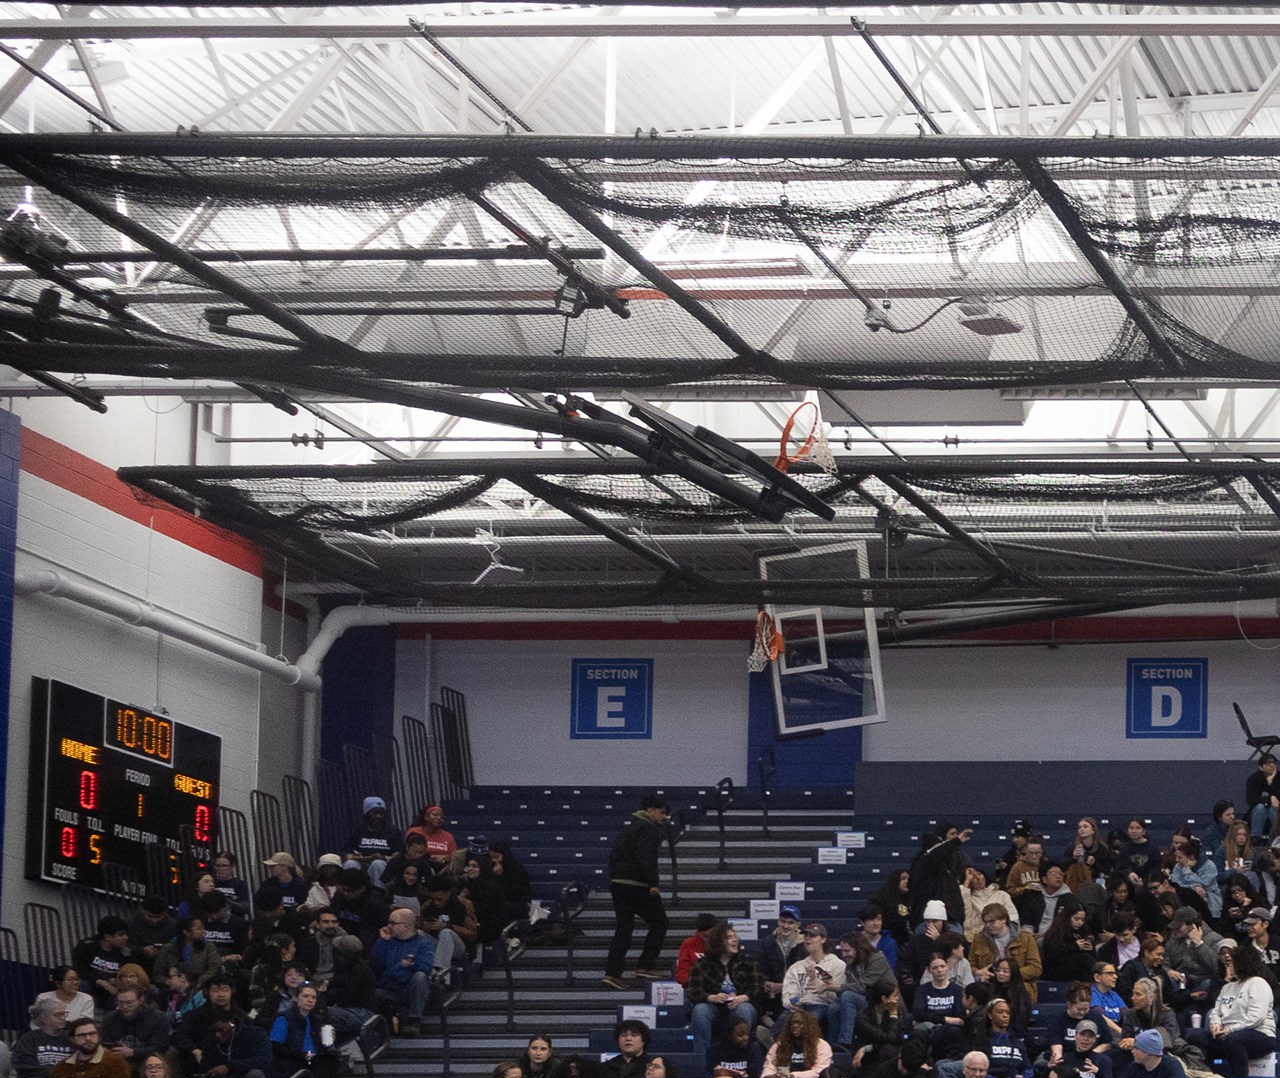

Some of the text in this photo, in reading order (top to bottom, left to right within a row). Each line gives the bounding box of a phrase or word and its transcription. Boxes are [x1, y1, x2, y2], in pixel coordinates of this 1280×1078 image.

[587, 669, 638, 683] SECTION
[1141, 668, 1192, 682] SECTION
[597, 686, 627, 728] E
[1151, 686, 1182, 727] D
[117, 709, 171, 759] 10:00
[61, 737, 100, 764] HOME
[80, 770, 97, 810] 0
[126, 768, 150, 787] PERIOD
[174, 773, 212, 799] GUEST
[54, 807, 79, 826] FOULS
[61, 826, 77, 858] 0
[114, 824, 139, 841] PLAYER
[90, 834, 101, 864] 5
[52, 862, 77, 880] SCORE
